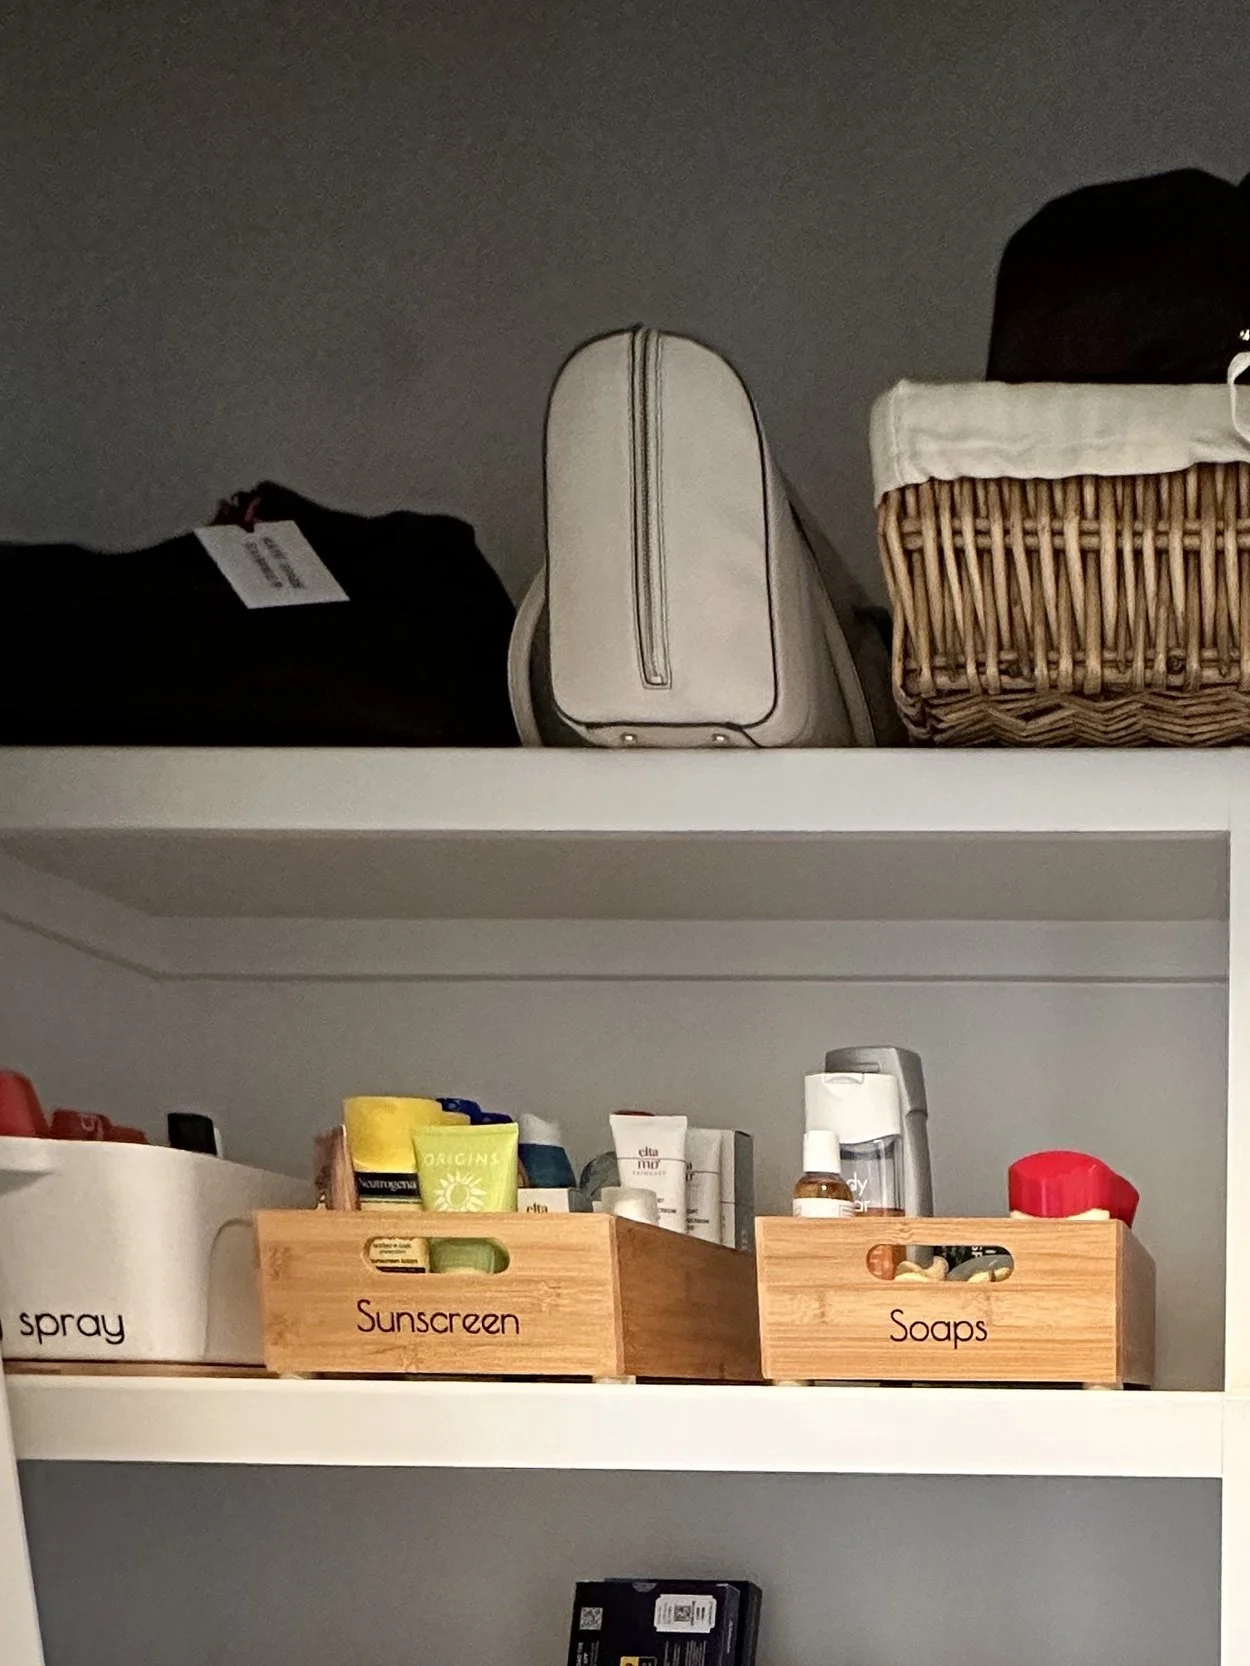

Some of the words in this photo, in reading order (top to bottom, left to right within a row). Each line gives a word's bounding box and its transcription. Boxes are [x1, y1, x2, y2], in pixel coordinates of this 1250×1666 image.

[424, 1152, 500, 1167] ORIGINS
[358, 1177, 418, 1191] Neutrogena
[20, 1312, 125, 1345] spray
[356, 1299, 519, 1336] Sunscreen
[890, 1308, 988, 1349] Soaps
